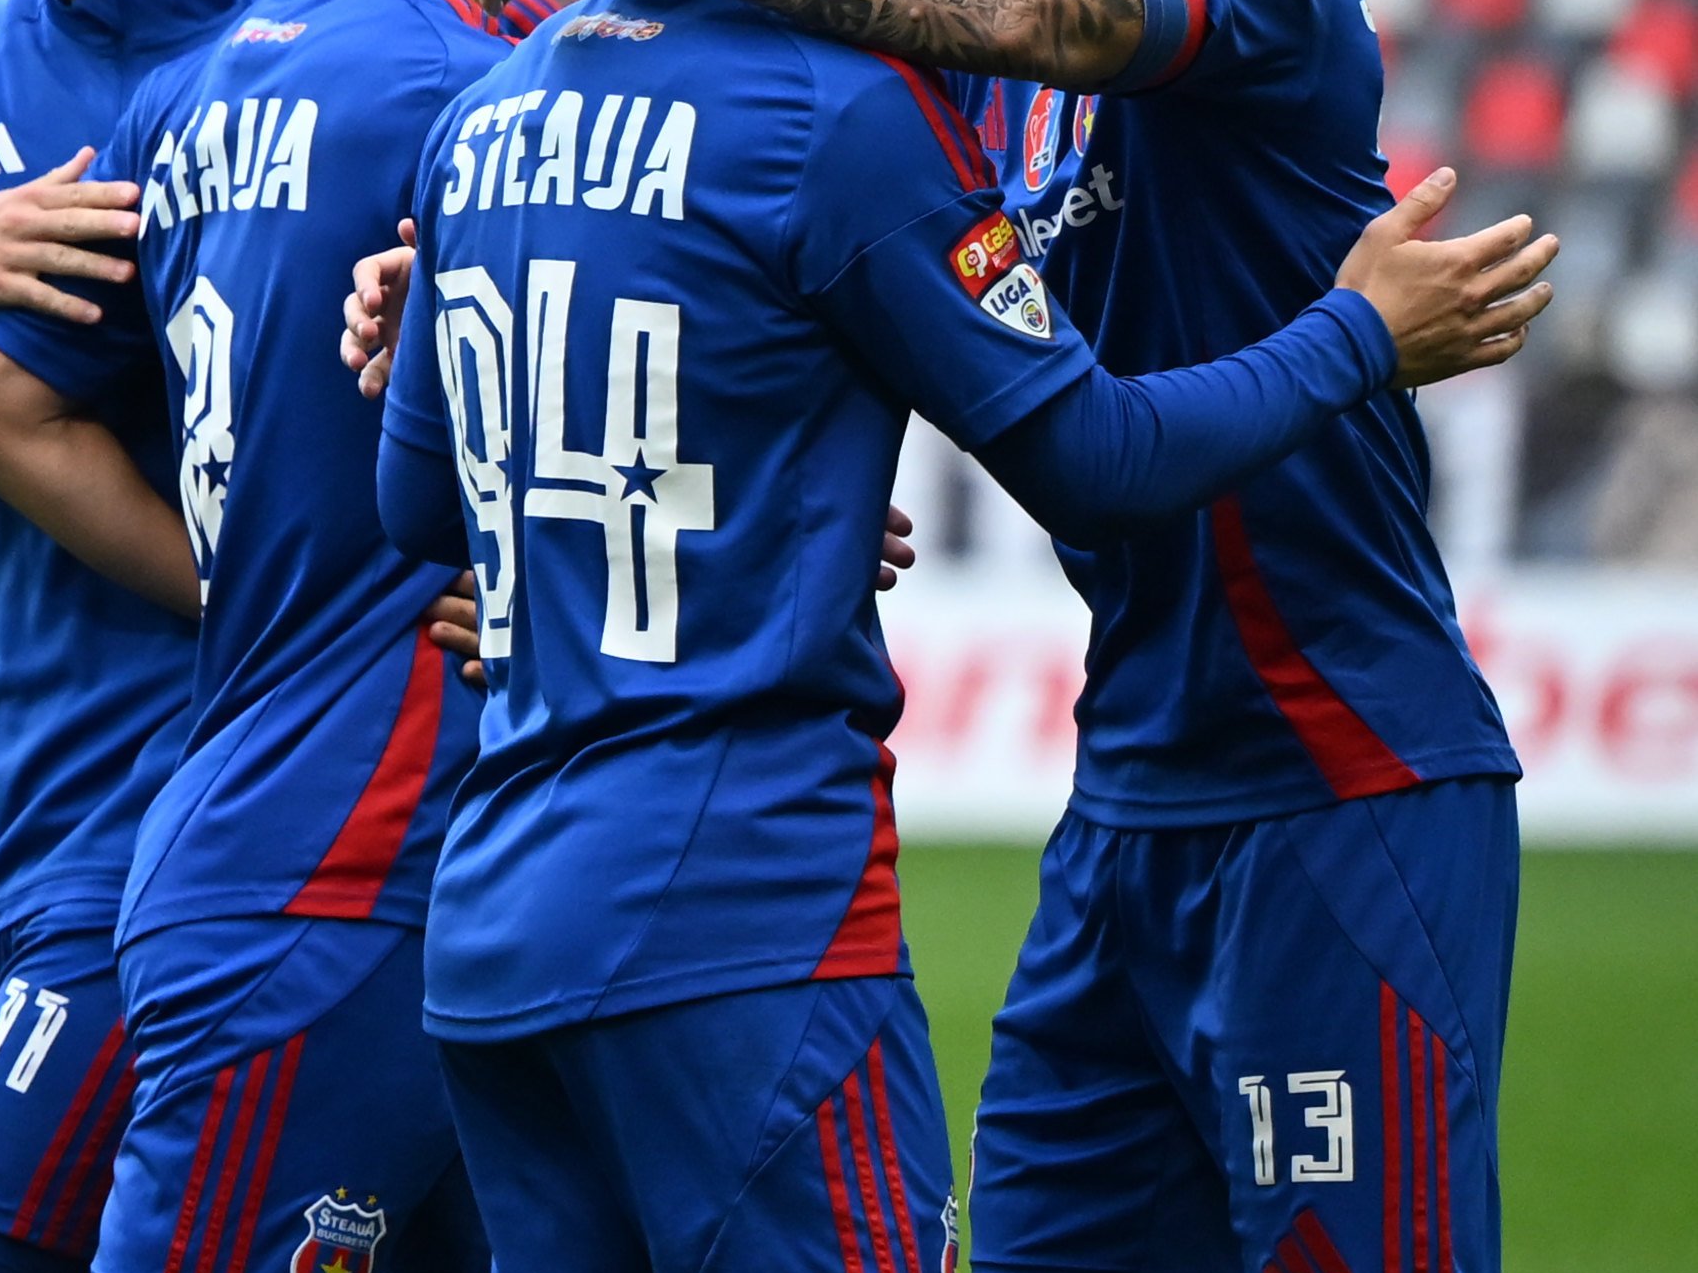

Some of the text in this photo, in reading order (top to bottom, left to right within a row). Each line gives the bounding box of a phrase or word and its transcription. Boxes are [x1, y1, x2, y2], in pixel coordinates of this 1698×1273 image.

[443, 89, 697, 222] STEAUA
[990, 277, 1032, 316] LIGA
[435, 258, 715, 664] 94
[1238, 1069, 1354, 1186] 13
[318, 1207, 376, 1239] STEAUA
